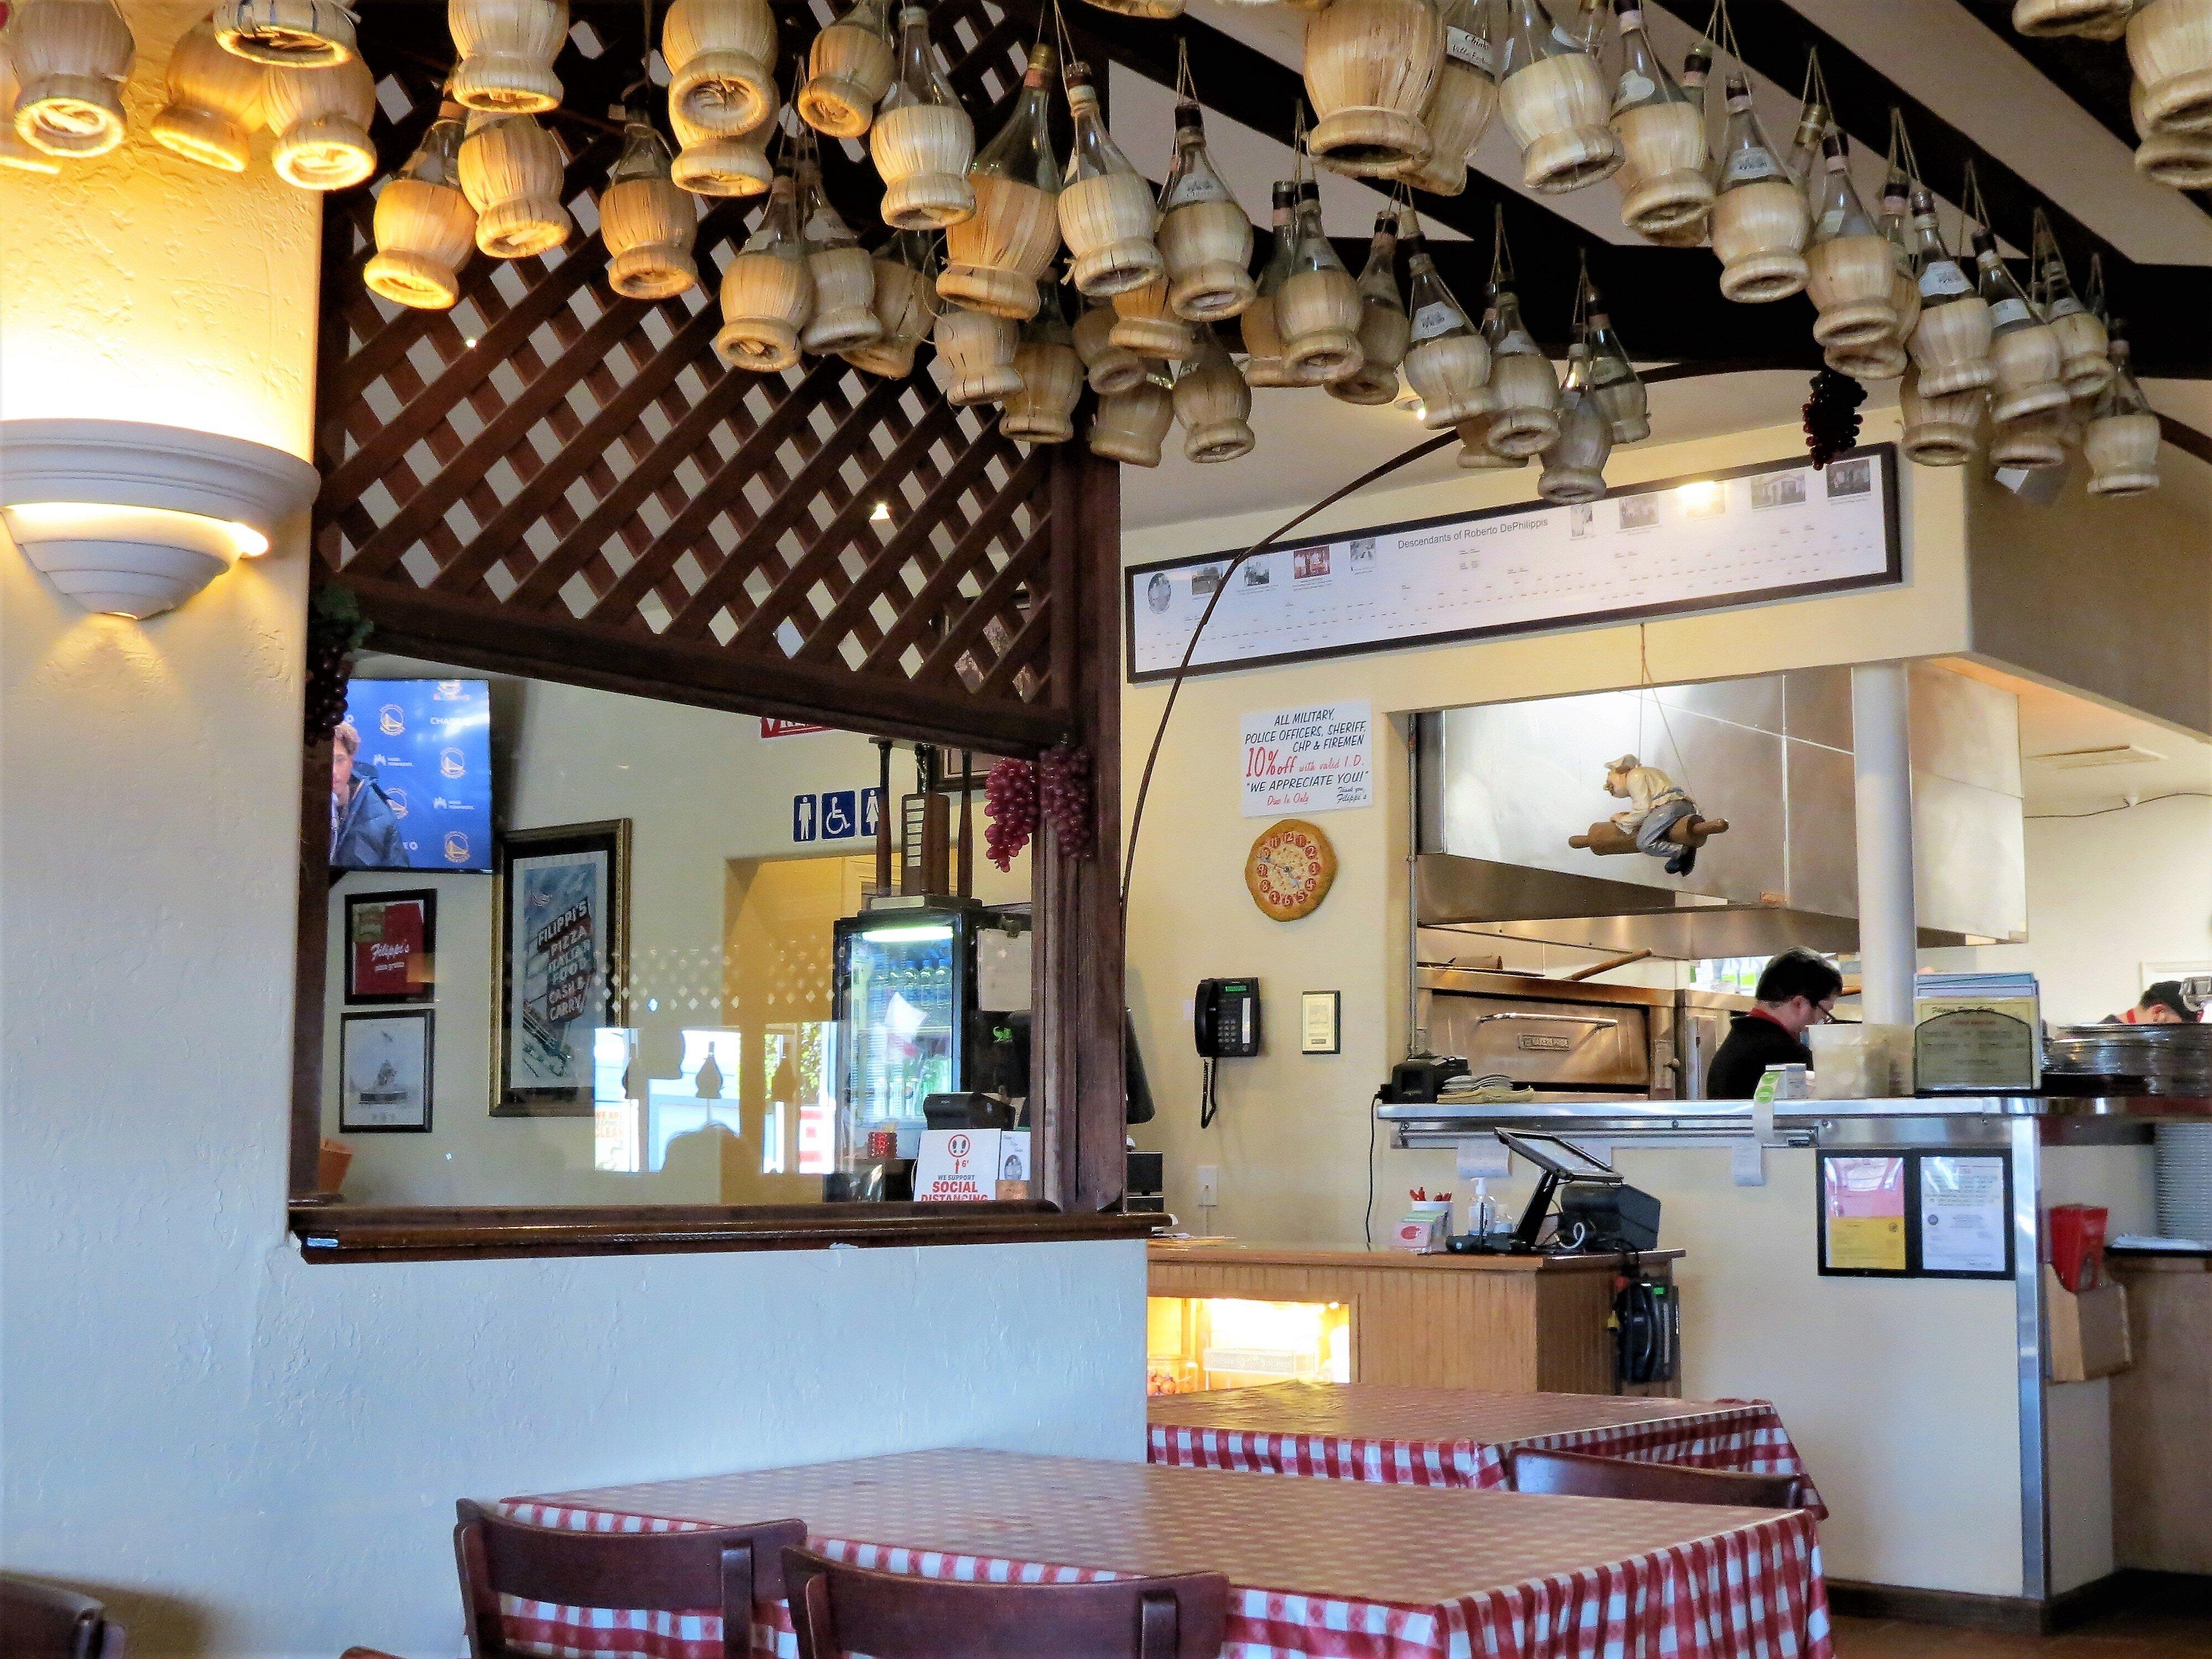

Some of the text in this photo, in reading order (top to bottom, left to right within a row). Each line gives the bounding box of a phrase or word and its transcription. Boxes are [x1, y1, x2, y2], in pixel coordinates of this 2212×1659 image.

[1399, 518, 1548, 549] Descendants of Roberto DePhilippis
[1274, 708, 1335, 726] ALL MILITARY,
[1245, 721, 1366, 744] POLICE OFFICERS, SHERIFF,
[1293, 734, 1365, 753] CHP & FIREMEN
[1277, 755, 1297, 775] off
[1269, 775, 1333, 791] APPRECIATE
[932, 1181, 978, 1193] SOCIAL
